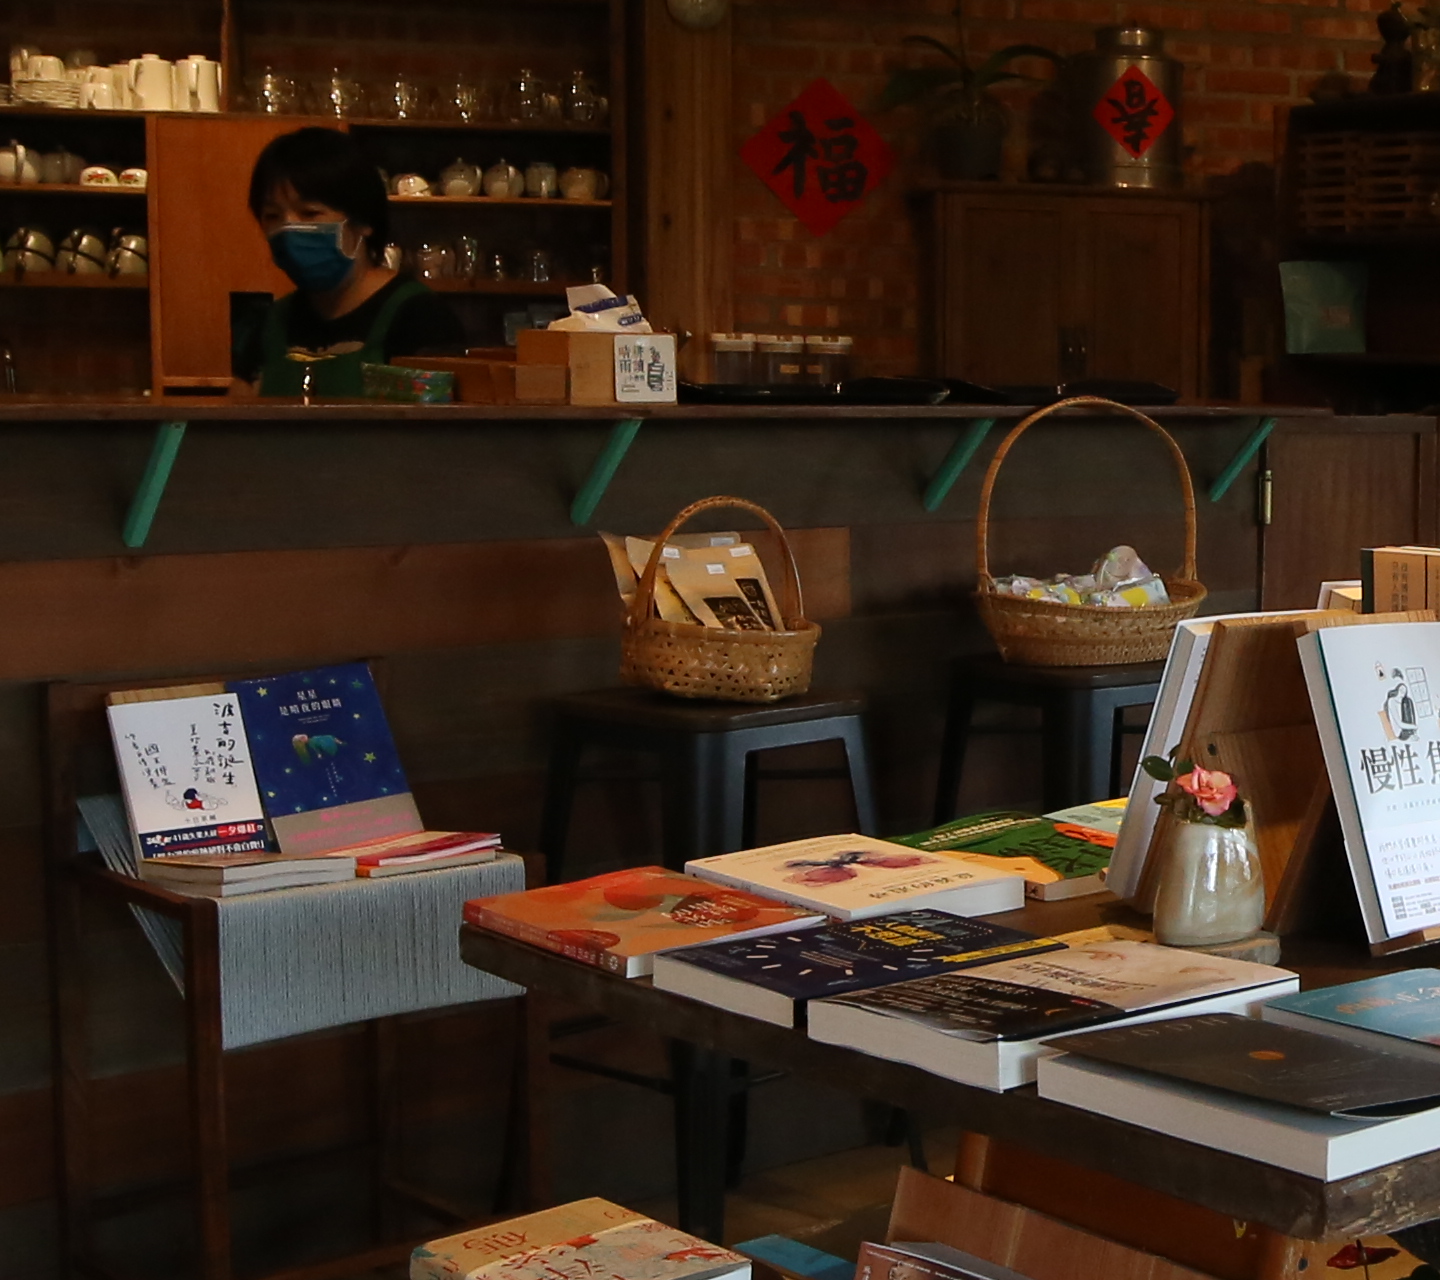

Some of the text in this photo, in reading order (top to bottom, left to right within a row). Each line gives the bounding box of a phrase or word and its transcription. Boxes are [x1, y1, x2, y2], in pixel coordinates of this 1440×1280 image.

[772, 111, 870, 204] 福
[296, 689, 319, 702] 星星
[213, 702, 244, 786] 波吉的誕生
